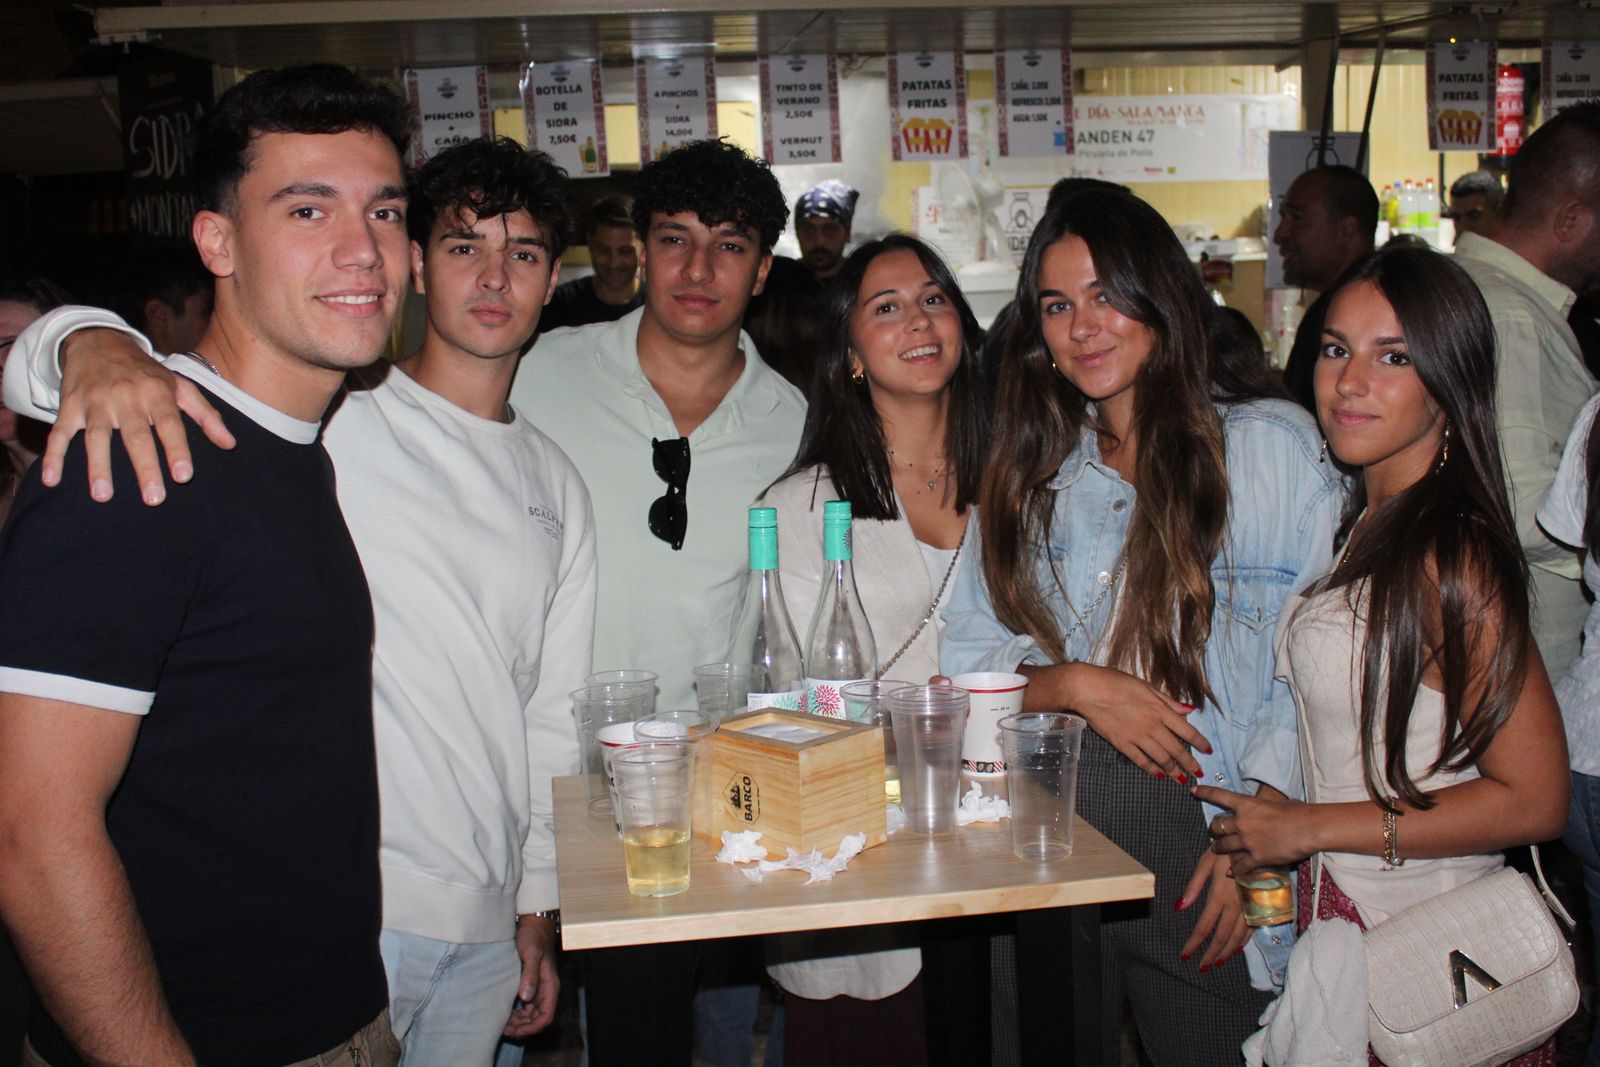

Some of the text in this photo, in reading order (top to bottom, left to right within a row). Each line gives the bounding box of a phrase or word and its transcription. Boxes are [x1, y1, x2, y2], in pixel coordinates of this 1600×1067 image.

[1438, 73, 1485, 84] PATATAS
[536, 84, 582, 96] BOTELLA
[775, 83, 822, 92] TINTO DE
[902, 80, 952, 91] PATATAS
[661, 89, 698, 98] PINCHOS
[1443, 91, 1479, 101] FRITAS
[777, 97, 821, 105] VERANO
[907, 98, 947, 109] FRITAS
[553, 102, 567, 111] DE
[424, 111, 474, 121] PINCHO
[785, 110, 813, 119] 2,50€
[545, 117, 577, 128] SIDRA
[665, 116, 690, 124] SIDRA
[549, 135, 577, 146] 7,50€
[780, 136, 822, 145] VERMUT
[1077, 130, 1155, 144] ANDEN 47
[743, 775, 753, 822] BARCO
